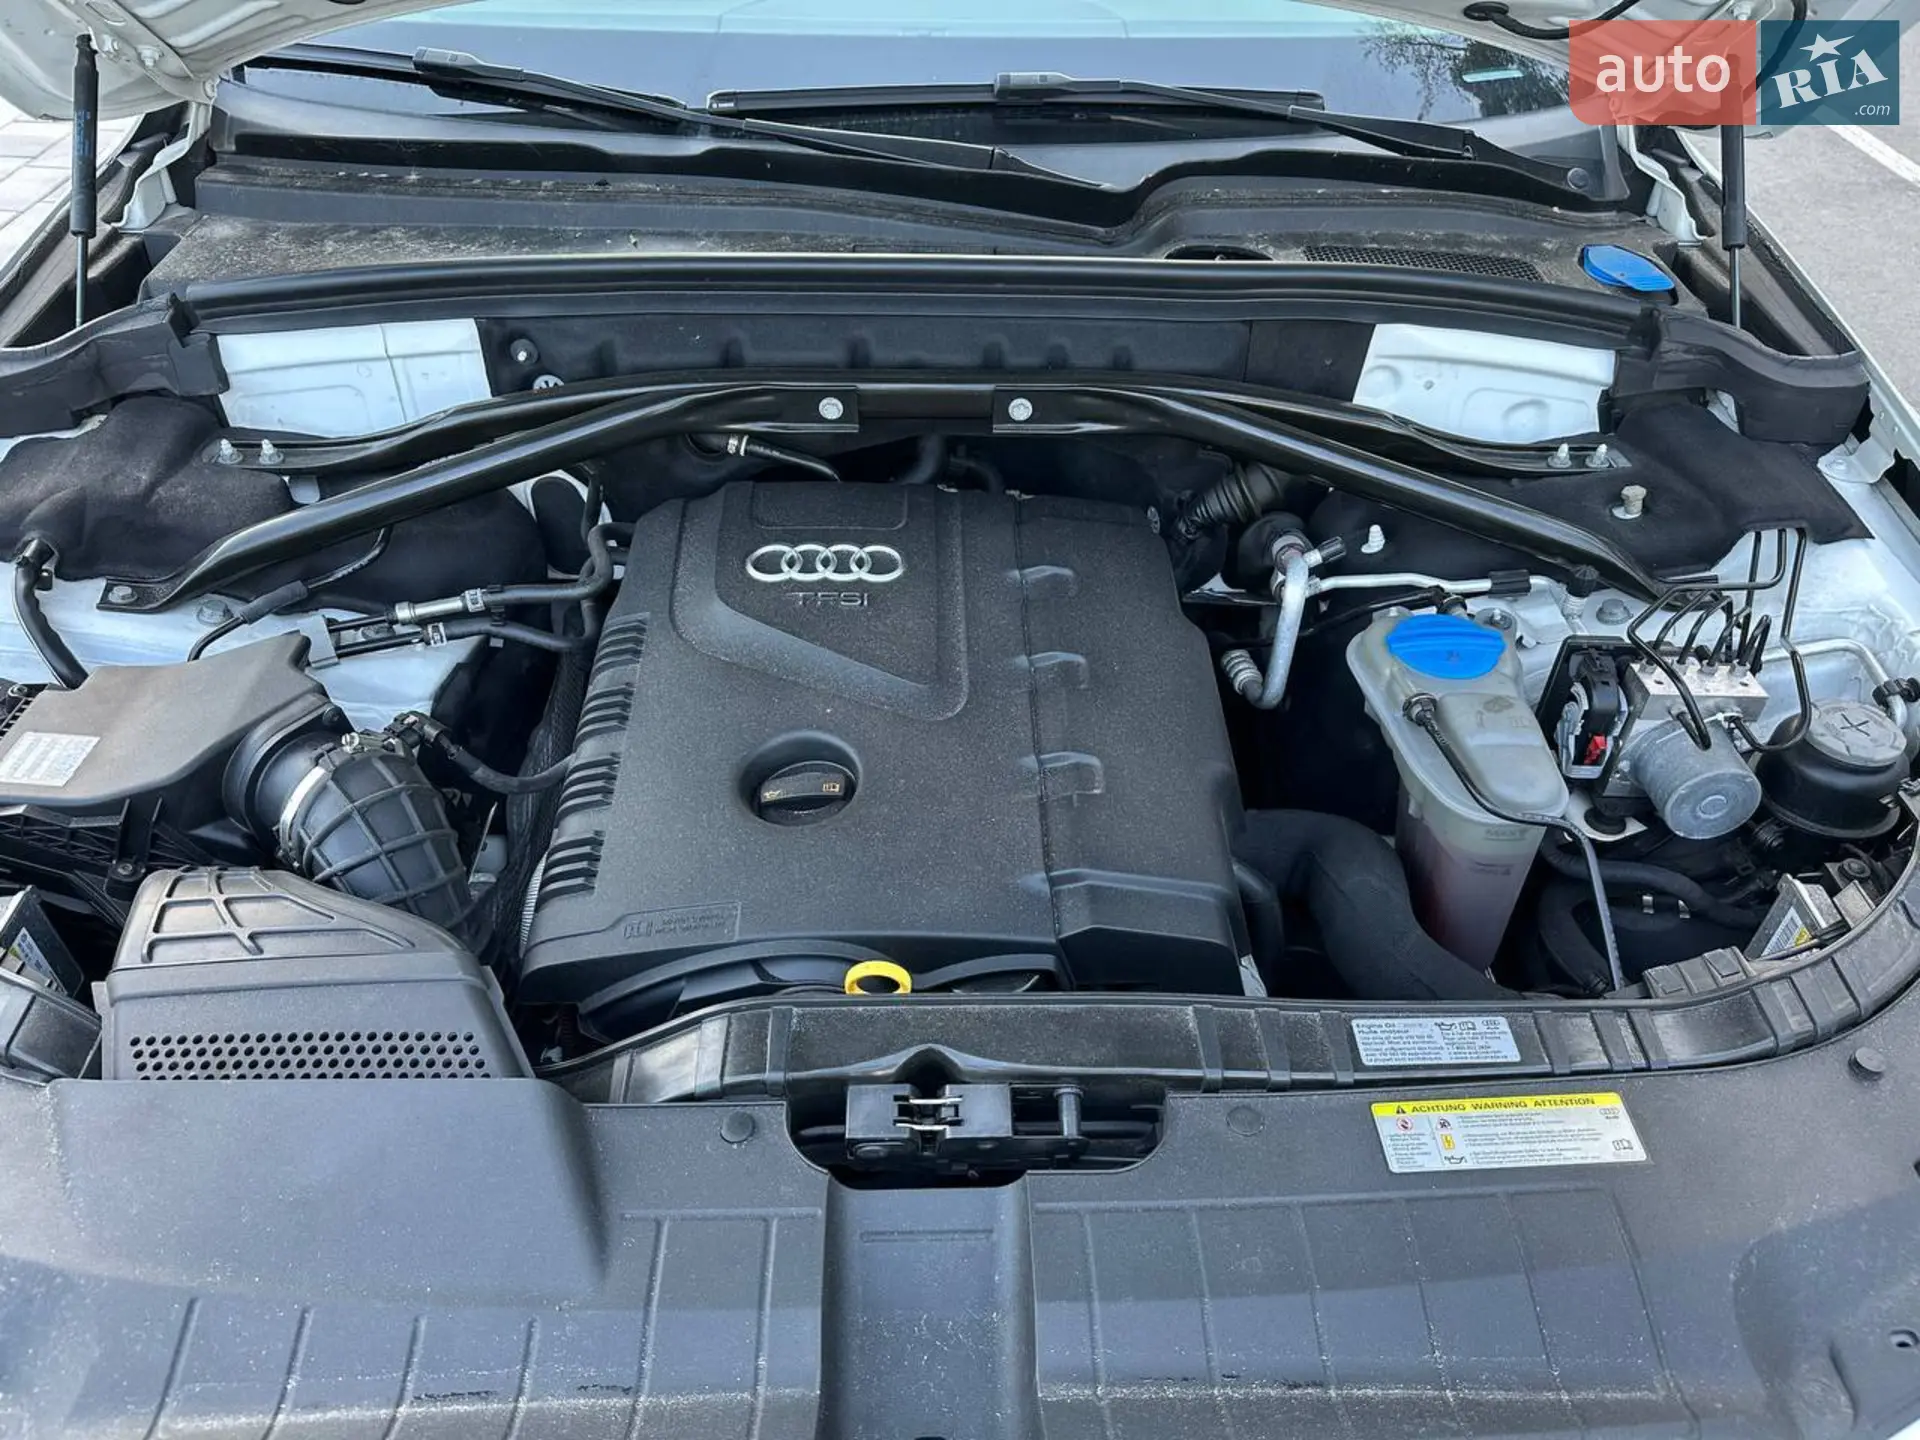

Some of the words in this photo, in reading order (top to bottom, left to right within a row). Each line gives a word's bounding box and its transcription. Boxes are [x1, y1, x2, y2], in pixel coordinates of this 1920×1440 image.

[786, 591, 868, 607] TFSI
[1411, 1103, 1466, 1113] ACHTUNG
[1471, 1100, 1528, 1110] WARNING
[1534, 1097, 1596, 1107] ATTENTION
